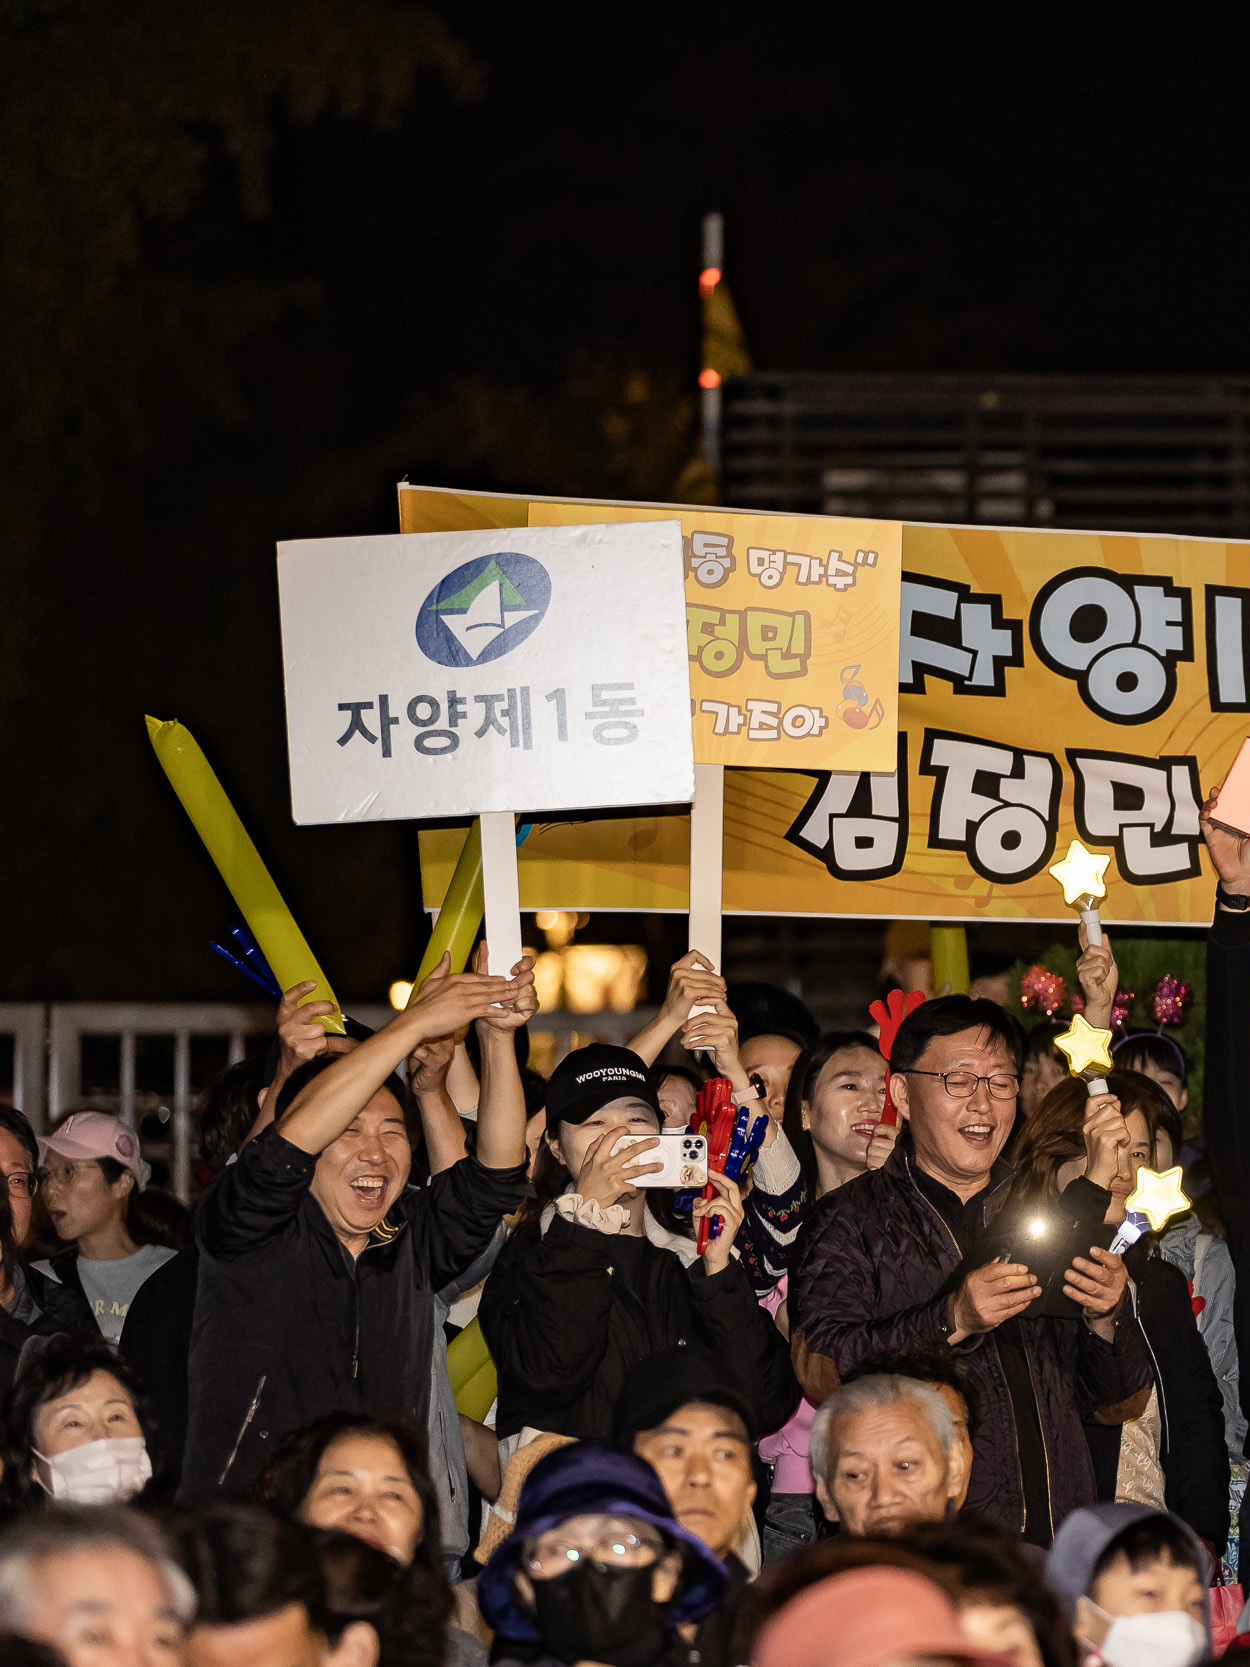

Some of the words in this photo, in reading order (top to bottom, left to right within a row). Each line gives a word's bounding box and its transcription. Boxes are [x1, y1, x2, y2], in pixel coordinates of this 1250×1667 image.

[684, 530, 736, 589] 동
[336, 680, 645, 759] 자양제1동
[576, 1067, 646, 1083] WOOYOUNGMI
